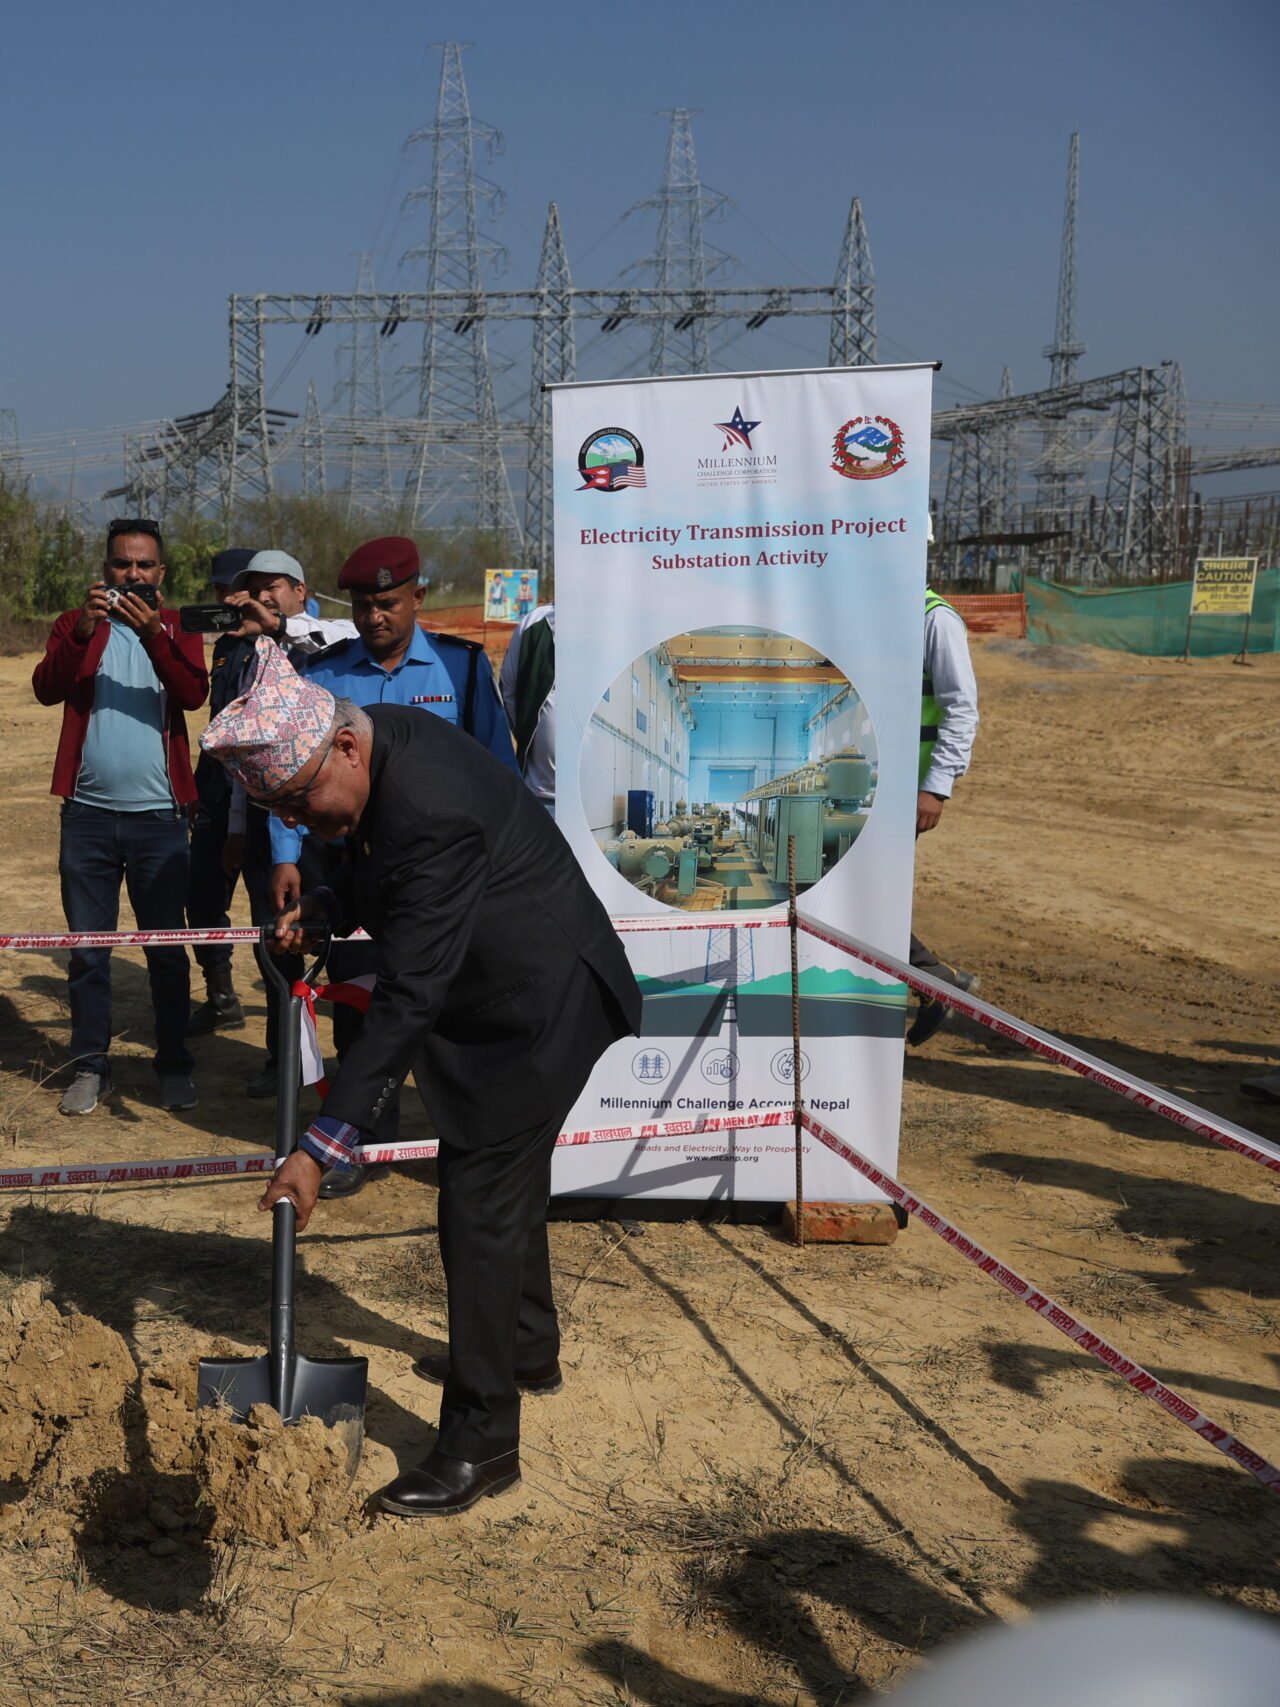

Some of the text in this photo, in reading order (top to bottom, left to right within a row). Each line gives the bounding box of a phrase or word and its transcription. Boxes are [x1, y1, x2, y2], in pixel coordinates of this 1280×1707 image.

[697, 455, 777, 469] MILLENNIUM
[697, 468, 777, 478] CHALLENGE CORPORATION
[580, 517, 907, 546] Electricity Transmission Project
[652, 550, 829, 570] Substation Activity
[1196, 571, 1252, 581] CAUTION
[600, 1097, 672, 1109] Millennium
[677, 1097, 744, 1111] Challenge
[810, 1098, 850, 1112] Nepal
[663, 1120, 693, 1133] खतरा
[723, 1114, 759, 1127] MEN AT
[592, 1126, 633, 1140] सावधान
[397, 1145, 439, 1159] सावधान
[635, 1144, 662, 1152] Roads
[664, 1144, 680, 1152] and
[683, 1145, 729, 1153] Electricity,
[732, 1145, 751, 1153] Way
[685, 1154, 759, 1163] www.mcanp.org
[66, 1169, 97, 1181] खतरा
[130, 1166, 169, 1178] MEN AT
[195, 1161, 238, 1175] सावधान
[955, 1234, 984, 1260] MEN AT
[996, 1264, 1030, 1295] सावधान
[1047, 1304, 1076, 1331] खतरा
[1096, 1342, 1136, 1375] MEN AT
[1152, 1384, 1200, 1423] सावधान
[1227, 1436, 1268, 1472] खतरा
